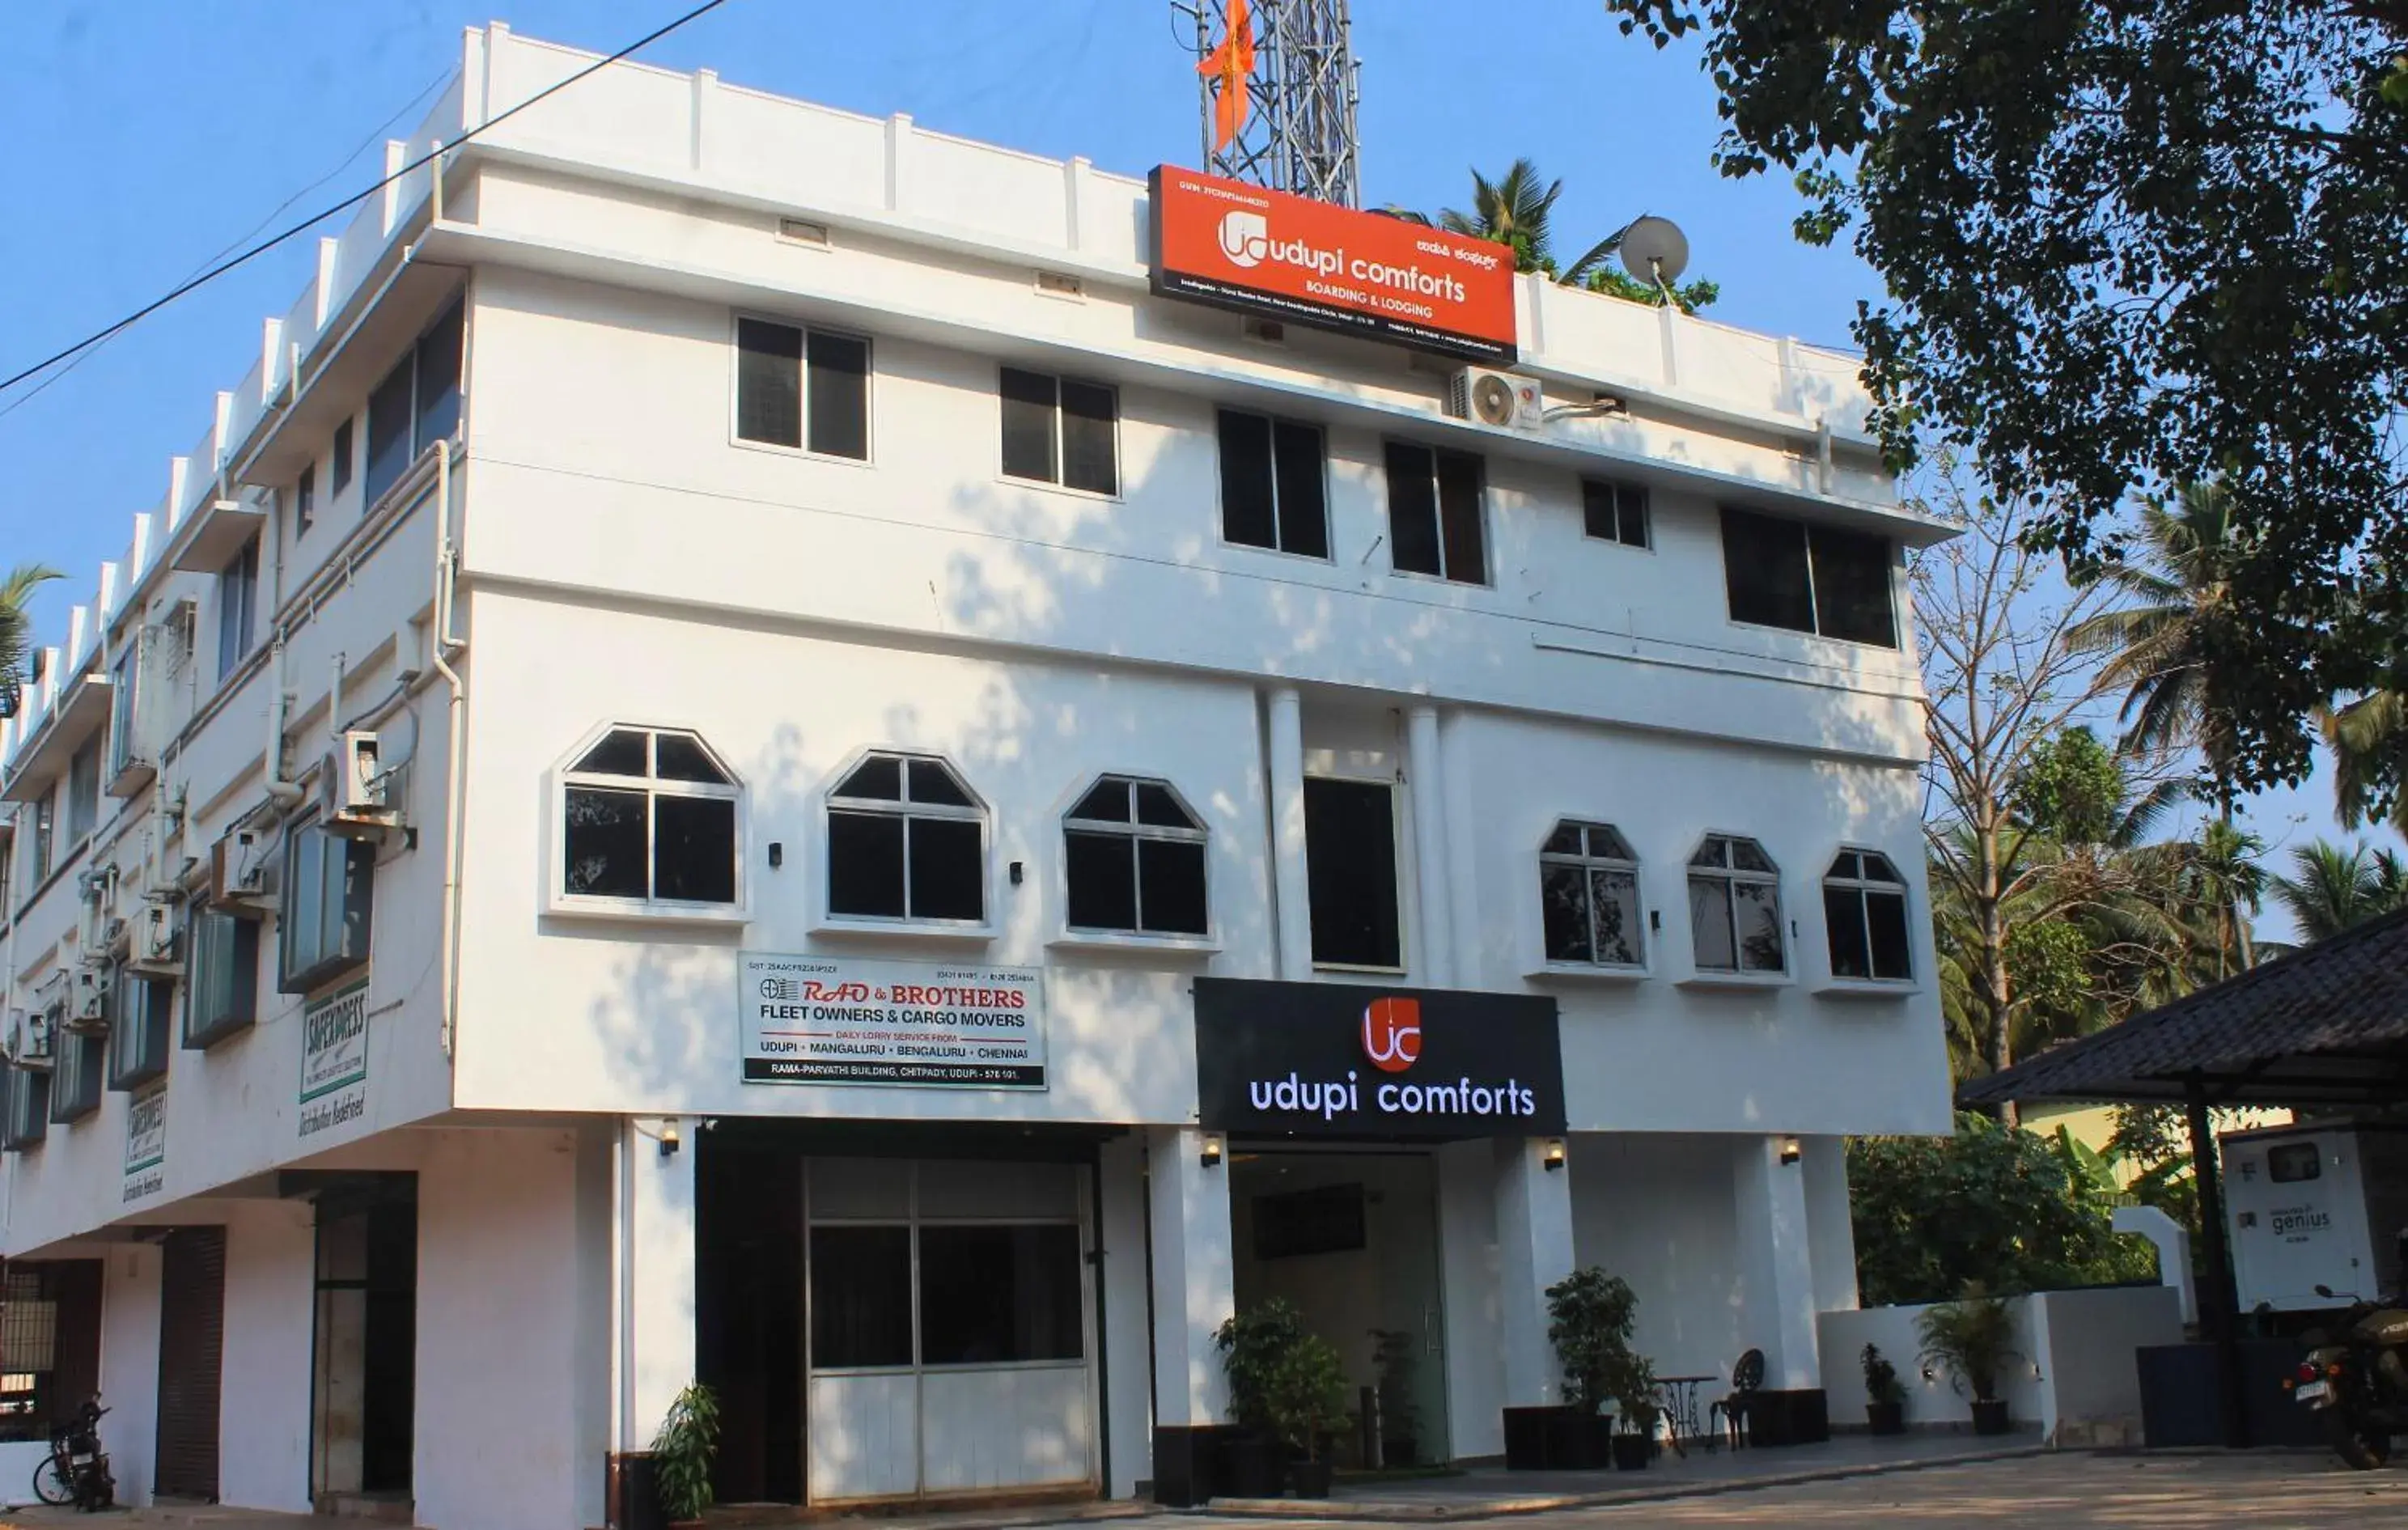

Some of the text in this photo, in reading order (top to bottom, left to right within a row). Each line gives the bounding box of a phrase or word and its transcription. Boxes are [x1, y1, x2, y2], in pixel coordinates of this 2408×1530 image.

[1270, 238, 1465, 303] udupi comforts
[1306, 280, 1433, 319] BOARDING & LODGING
[802, 981, 1024, 1009] RAO & BROTHERS
[308, 993, 364, 1056] SAFEXPRESS
[760, 1006, 1025, 1028] FLEET OWNERS & CARGO MOVERS
[836, 1031, 958, 1043] DAILY LORRY SERVICE FROM
[761, 1041, 1028, 1059] UDUPI MANGALURU BENGALURU CHENNAI
[771, 1063, 849, 1075] RAMA-PARVATHI
[950, 1068, 977, 1079] UDUPI
[1250, 1070, 1535, 1120] udupi comforts
[2272, 1213, 2330, 1235] genius
